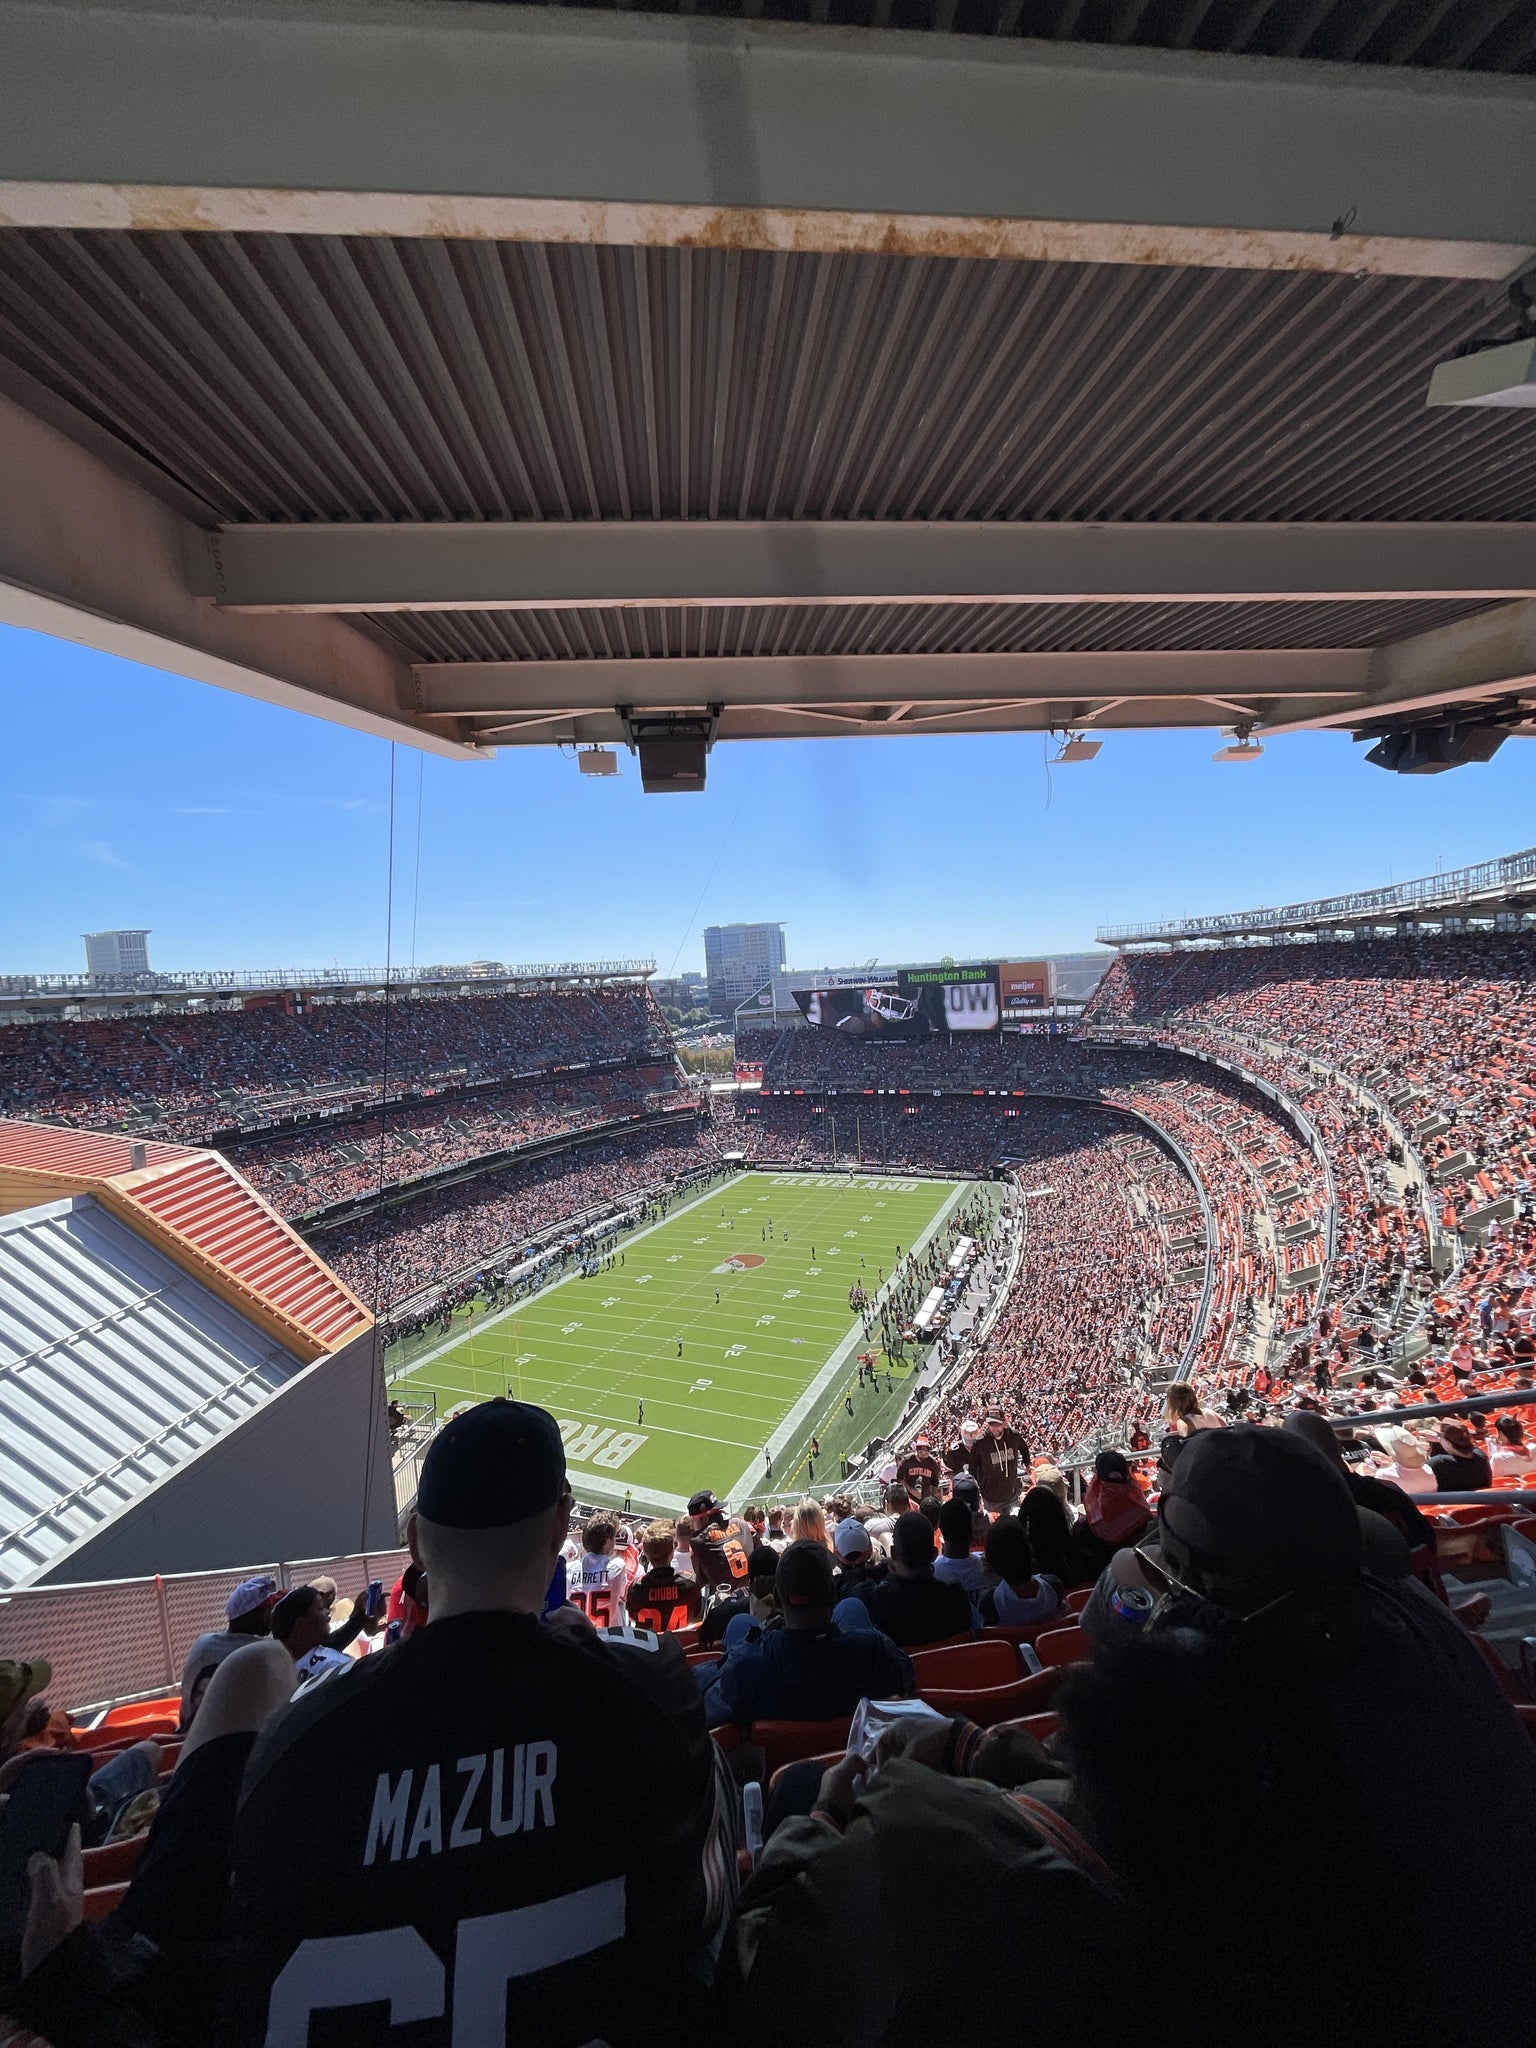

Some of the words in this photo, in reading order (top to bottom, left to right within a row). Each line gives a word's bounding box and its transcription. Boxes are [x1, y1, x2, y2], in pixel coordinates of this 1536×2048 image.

[837, 975, 898, 986] SHERWIN-WILLIAMS
[908, 972, 960, 984] Huntington
[961, 969, 987, 981] Bank
[1011, 981, 1035, 992] meijer
[770, 1177, 919, 1192] CLEVELAND
[756, 1314, 776, 1326] 30
[726, 1344, 747, 1357] 20
[691, 1378, 713, 1392] 10
[908, 1466, 932, 1478] CLEVELAND
[723, 1539, 749, 1579] 6
[571, 1570, 609, 1585] GARRETT
[648, 1586, 678, 1601] CHUBB
[363, 1740, 557, 1867] MAZUR
